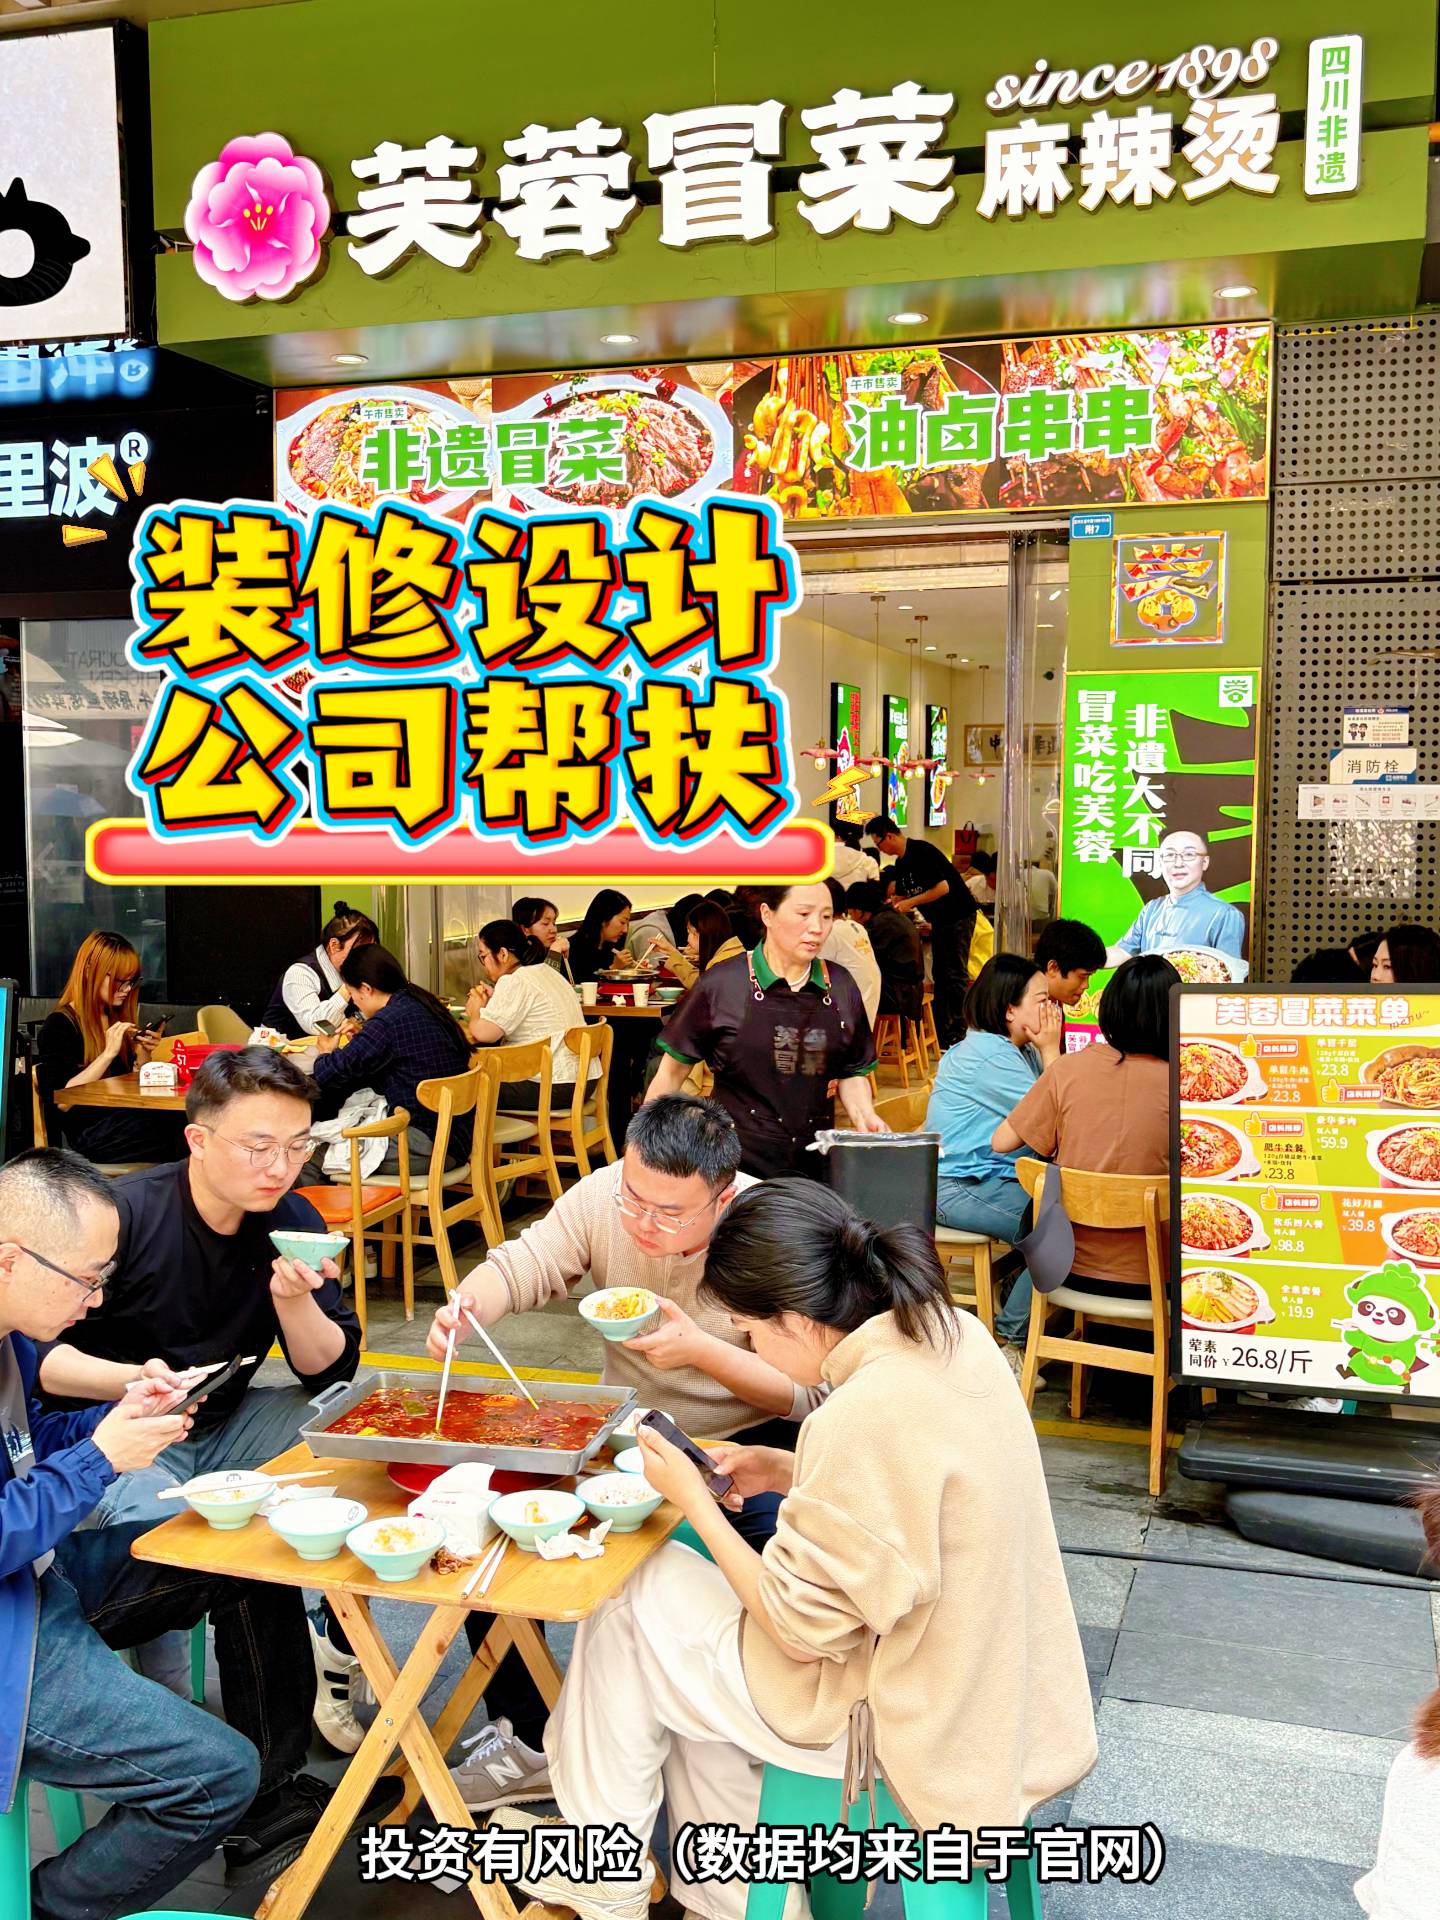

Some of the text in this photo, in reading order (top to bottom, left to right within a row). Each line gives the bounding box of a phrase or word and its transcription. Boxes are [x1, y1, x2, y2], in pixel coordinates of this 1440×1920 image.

[1315, 45, 1351, 185] 四川非遗
[347, 80, 956, 278] 芙蓉冒菜
[978, 92, 1281, 218] 麻辣烫
[850, 377, 899, 391] 午市售卖
[363, 407, 404, 420] 午市售卖
[847, 384, 1159, 471] 油卤串串
[361, 414, 628, 491] 非遗冒菜
[1072, 690, 1118, 864] 冒菜吃芙蓉
[1347, 759, 1399, 774] 消防栓
[1215, 996, 1411, 1026] 芙蓉冒菜菜单
[1189, 1338, 1217, 1353] 荤素
[1189, 1354, 1217, 1369] 同价
